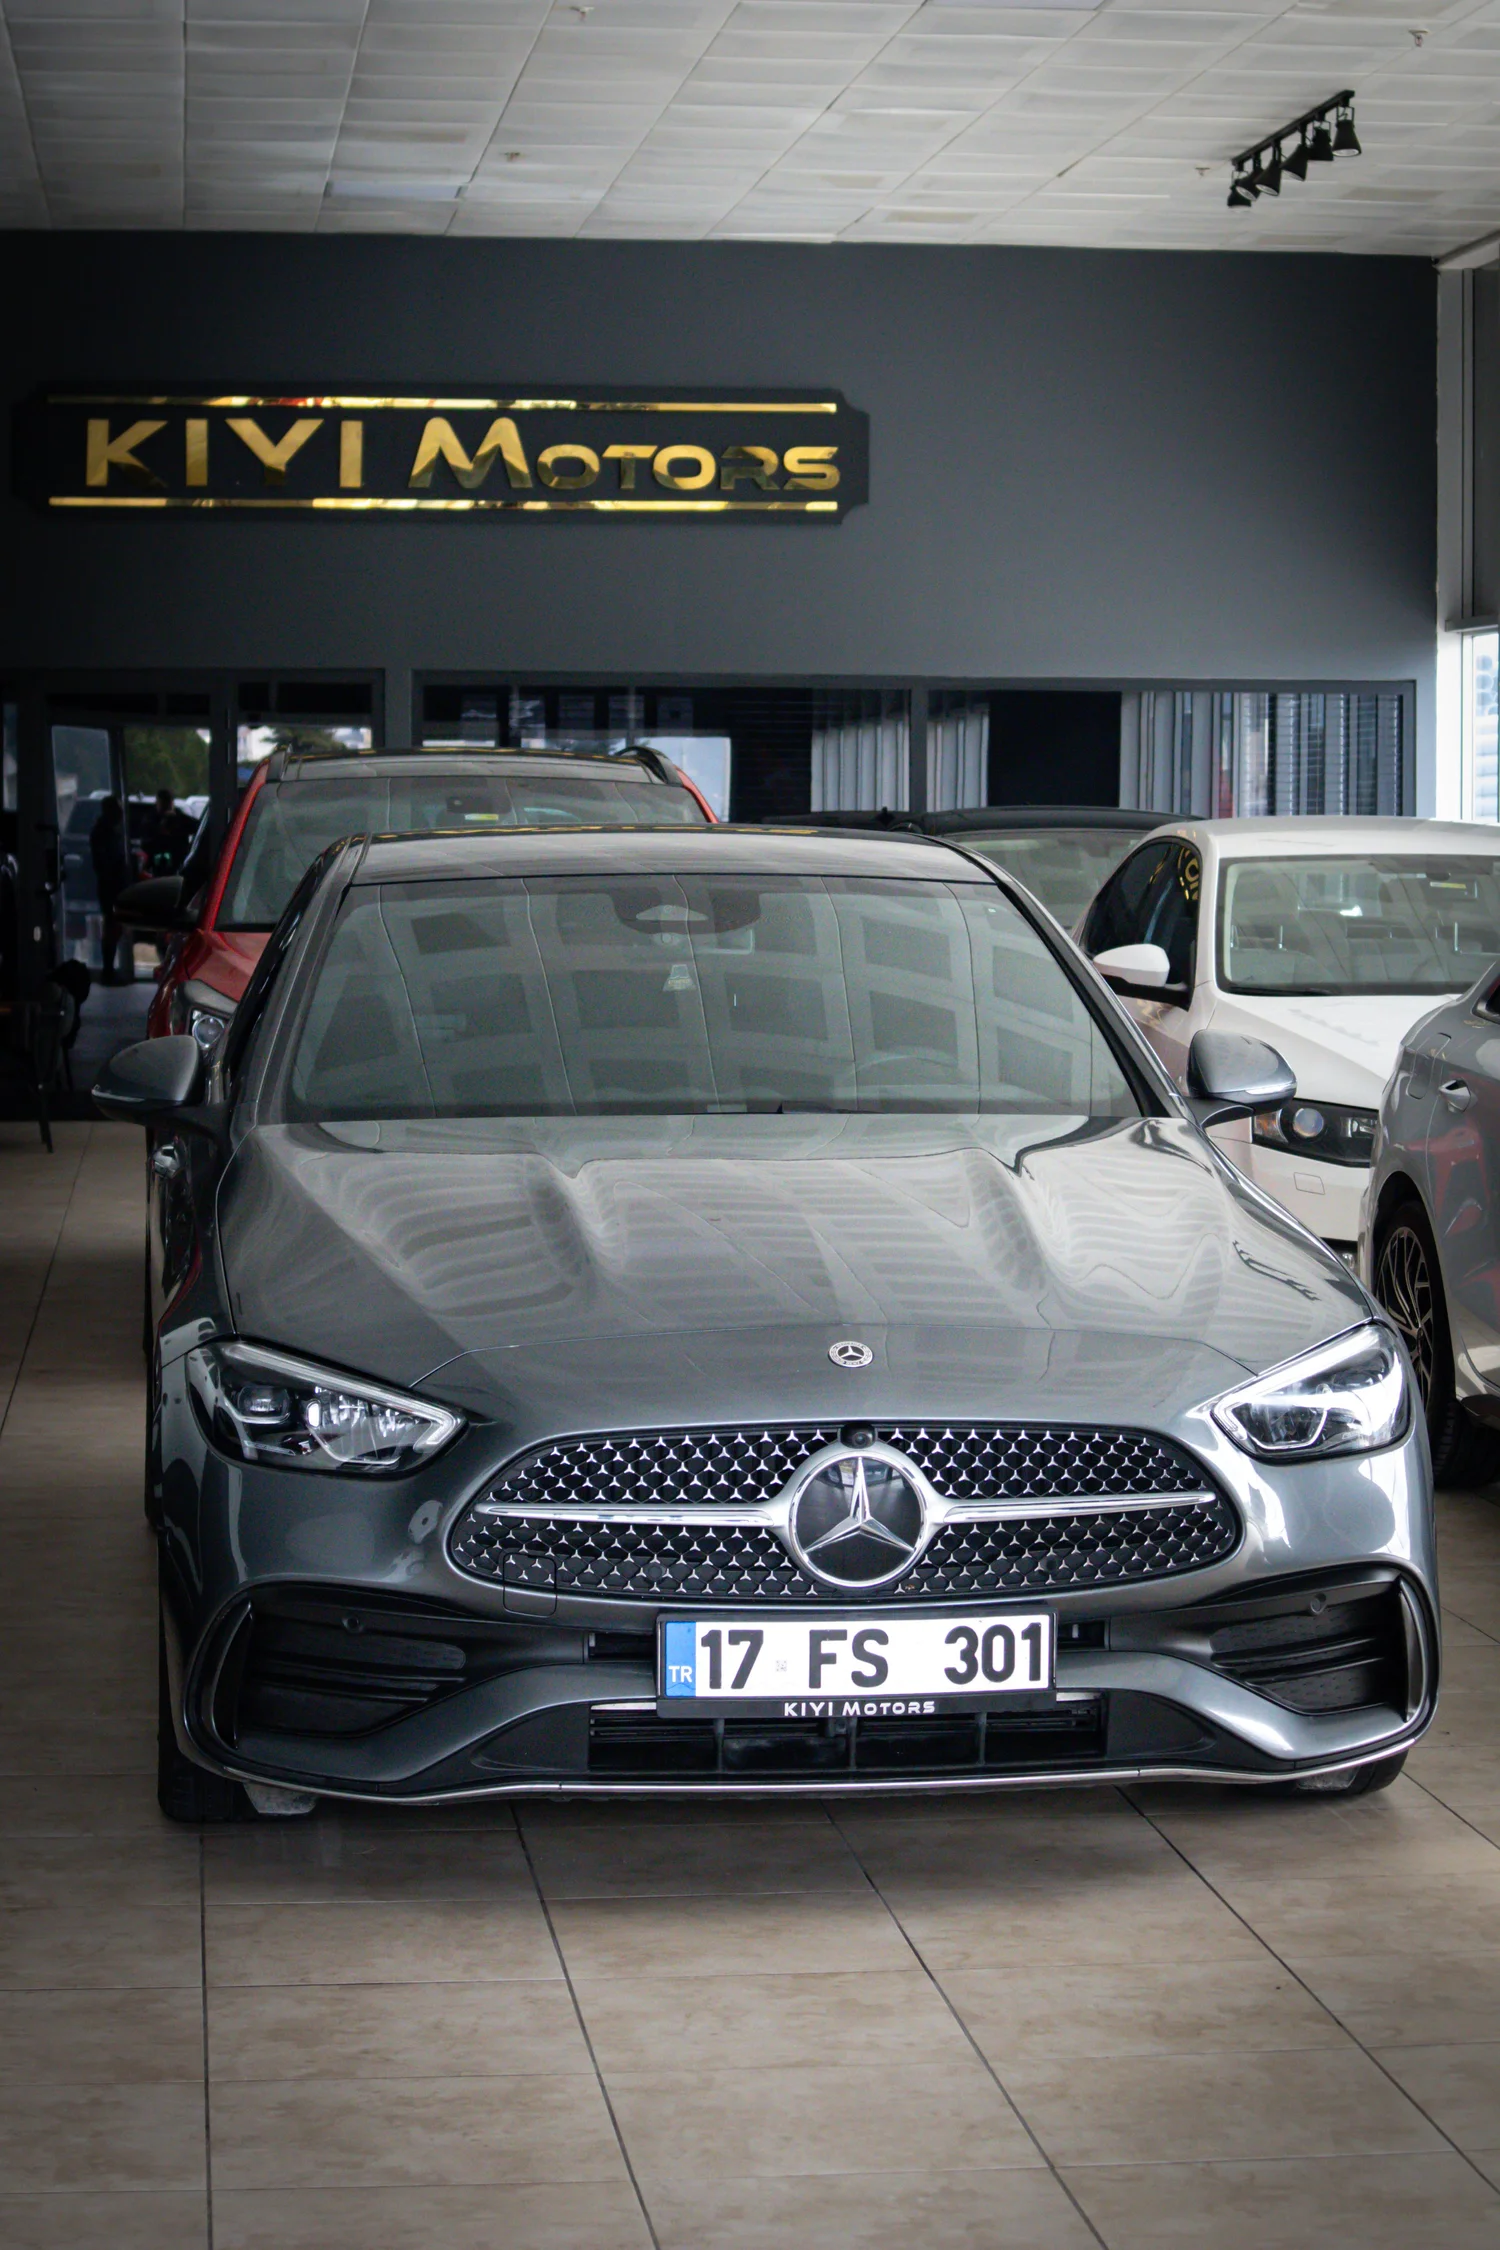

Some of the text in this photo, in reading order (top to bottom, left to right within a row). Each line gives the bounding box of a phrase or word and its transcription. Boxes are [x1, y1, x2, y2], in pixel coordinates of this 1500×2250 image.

[85, 416, 841, 491] KIYI MOTORS
[668, 1665, 693, 1684] TR
[701, 1622, 1042, 1690] 17 FS 301
[784, 1700, 936, 1717] KIYI MOTORS
